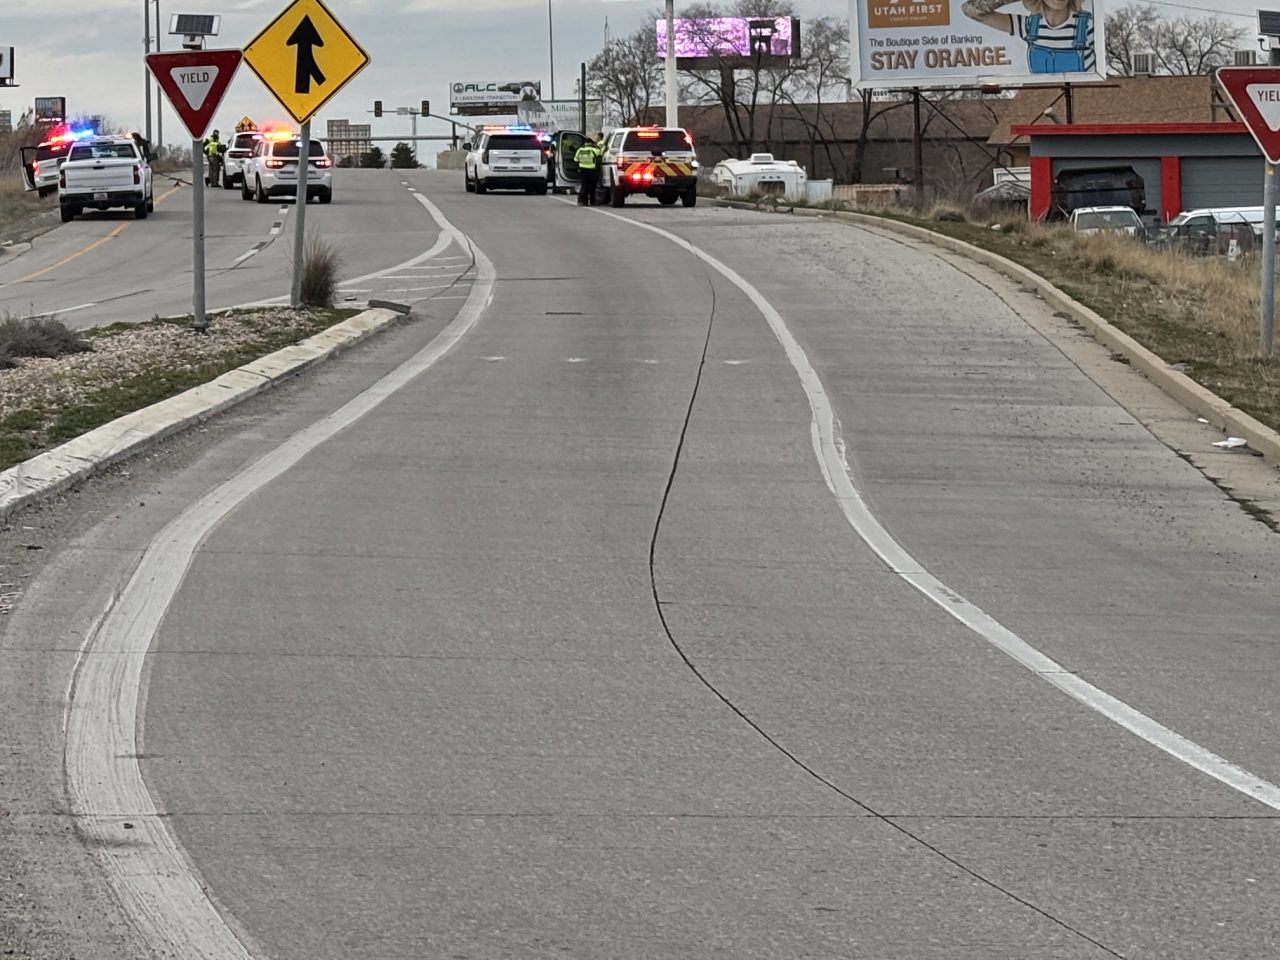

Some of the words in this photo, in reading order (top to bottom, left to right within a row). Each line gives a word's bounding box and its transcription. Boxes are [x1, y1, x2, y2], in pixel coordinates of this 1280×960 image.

[874, 6, 906, 16] UTAH
[909, 4, 943, 15] FIRST
[869, 38, 884, 47] The
[886, 37, 920, 48] Boutique
[921, 36, 938, 46] Side
[940, 35, 949, 45] of
[950, 34, 983, 45] Banking
[870, 49, 919, 71] STAY
[923, 46, 1012, 69] ORANGE.
[180, 71, 210, 84] YIELD
[464, 83, 497, 93] ALC
[1257, 90, 1280, 102] YIEL
